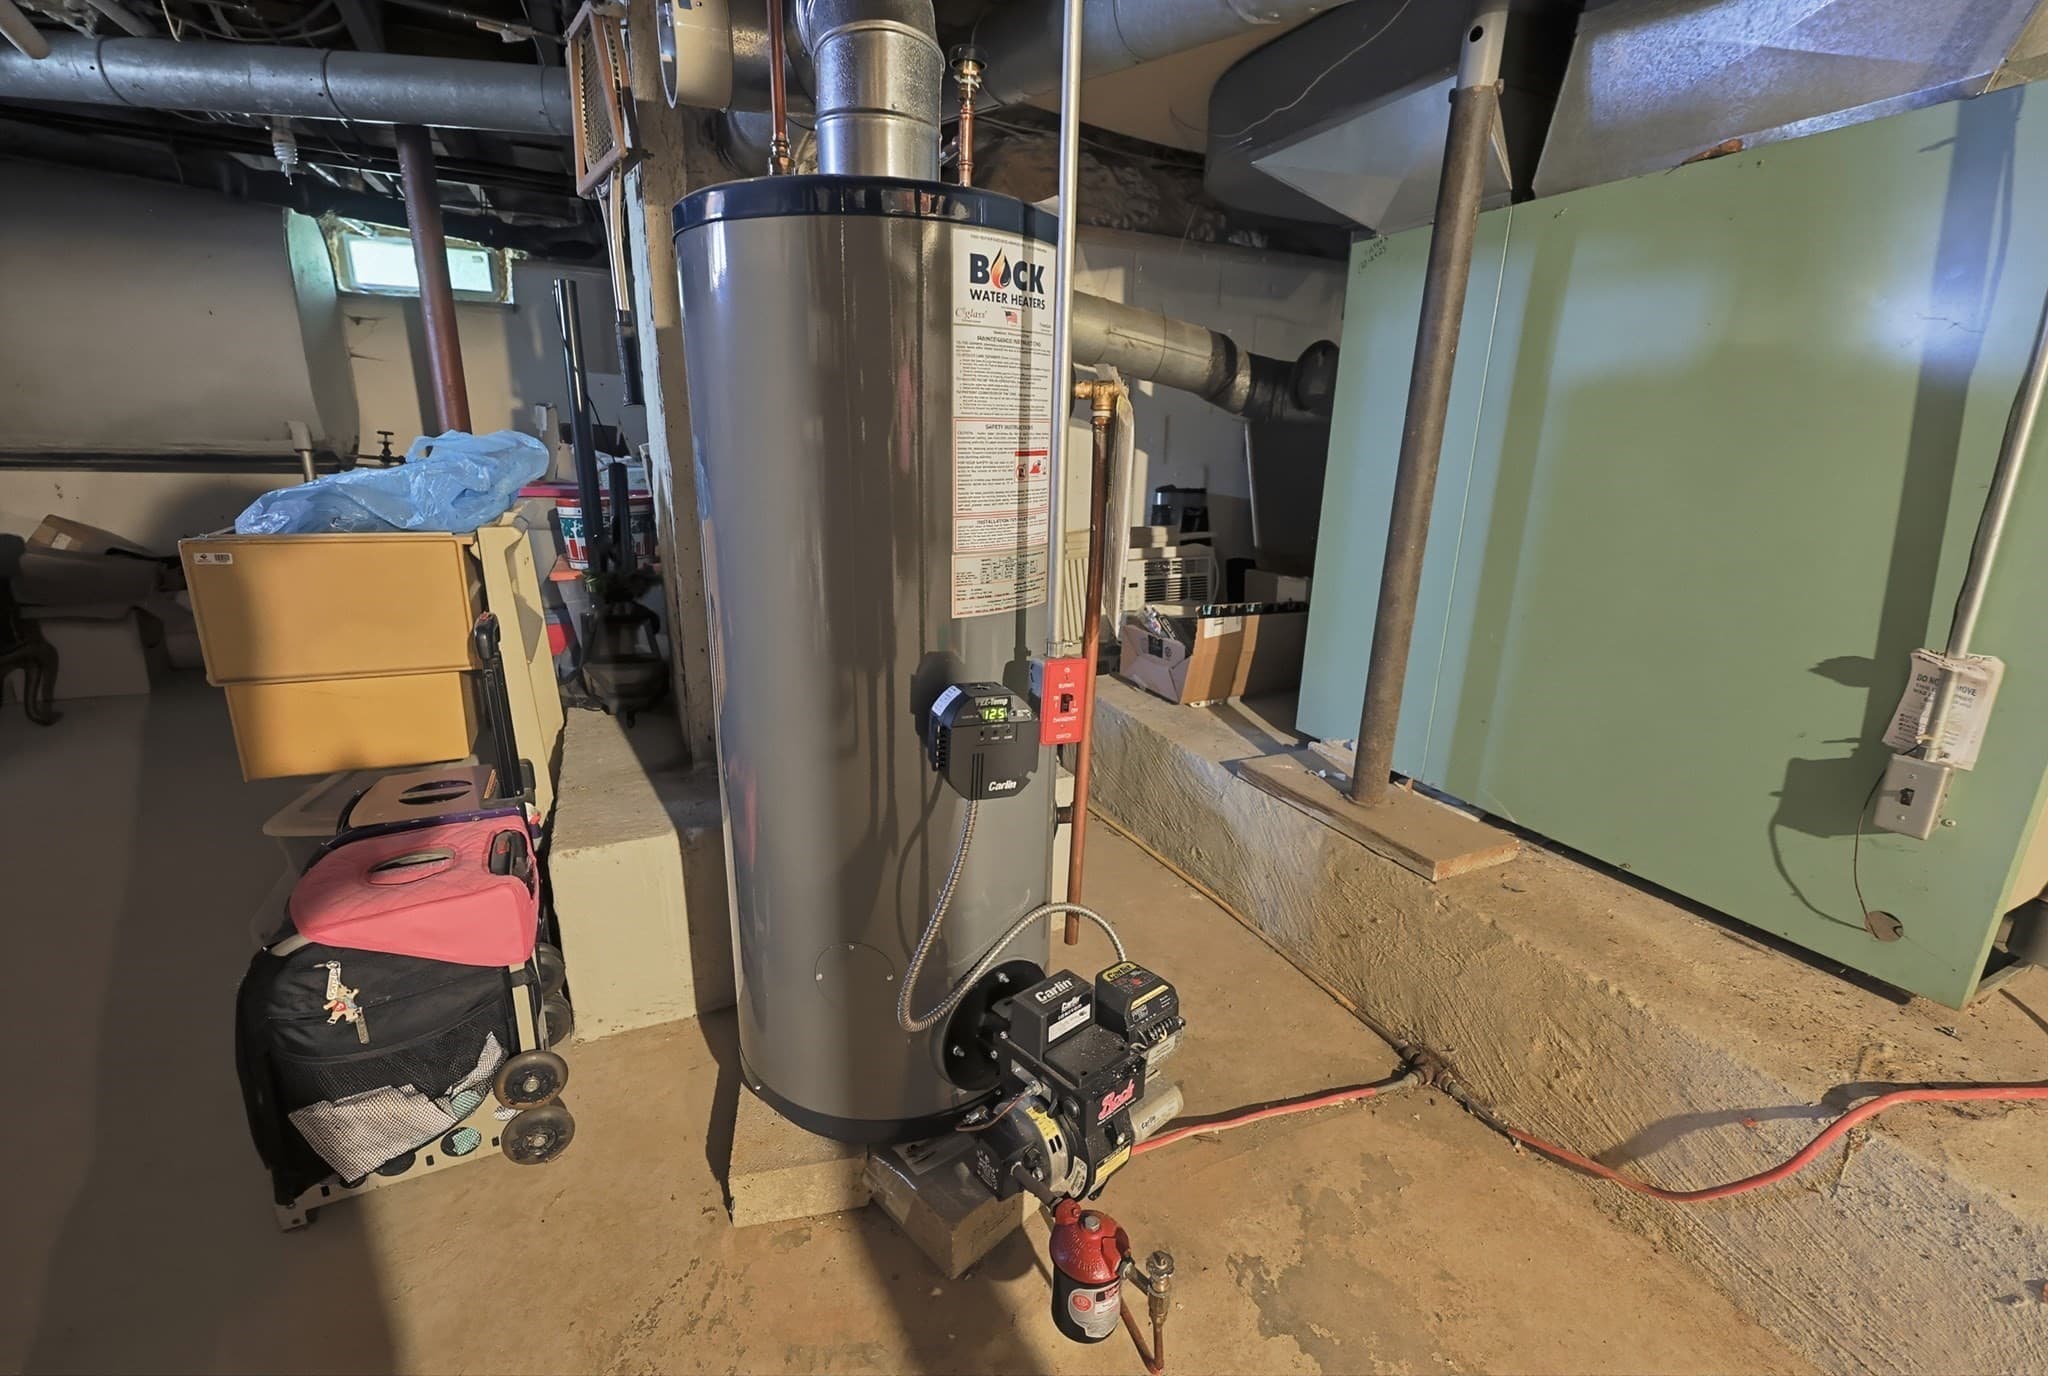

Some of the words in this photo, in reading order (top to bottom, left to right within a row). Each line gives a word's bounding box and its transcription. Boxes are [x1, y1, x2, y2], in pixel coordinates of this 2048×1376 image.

[970, 288, 1007, 304] WATER
[1011, 294, 1046, 310] HEATERS
[988, 779, 1017, 791] Carlin
[1035, 979, 1073, 1002] Carlin
